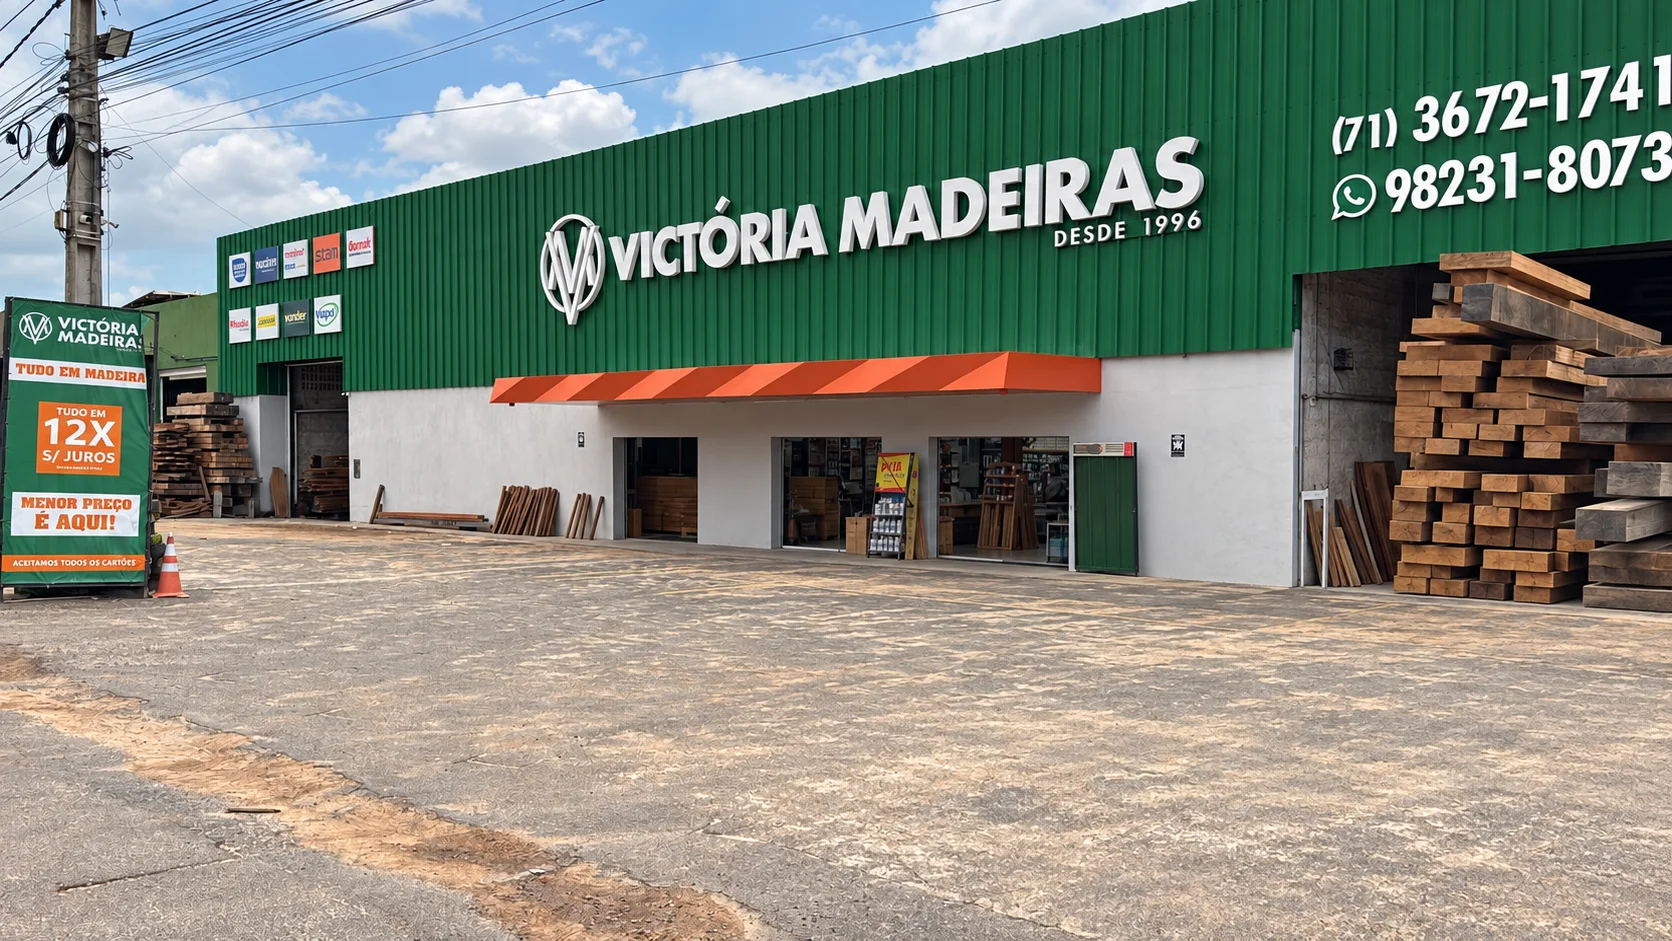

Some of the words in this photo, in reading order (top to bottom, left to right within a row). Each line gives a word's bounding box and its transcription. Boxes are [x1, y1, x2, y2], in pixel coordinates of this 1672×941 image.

[1331, 107, 1398, 155] (71)
[1412, 54, 1672, 142] 3672-1741
[1384, 130, 1672, 213] 98231-8073
[608, 195, 829, 281] VICTÓRIA
[838, 135, 1205, 253] MADEIRAS
[1054, 221, 1126, 248] DESDE
[1143, 209, 1203, 236] 1996
[315, 247, 339, 263] stam
[57, 316, 139, 336] VICTÓRIA
[15, 363, 55, 376] TUDO
[59, 366, 81, 378] EM
[84, 368, 146, 383] MADEIRA
[56, 407, 88, 417] TUDO
[90, 409, 106, 418] EM
[44, 418, 116, 447] 12X
[42, 449, 61, 464] S/
[63, 450, 116, 464] JUROS
[21, 497, 78, 510] MENOR
[82, 498, 132, 513] PREÇO
[34, 510, 50, 530] É
[55, 513, 117, 532] AQUI!
[12, 559, 59, 567] ACEITAMOS
[89, 559, 101, 567] OS
